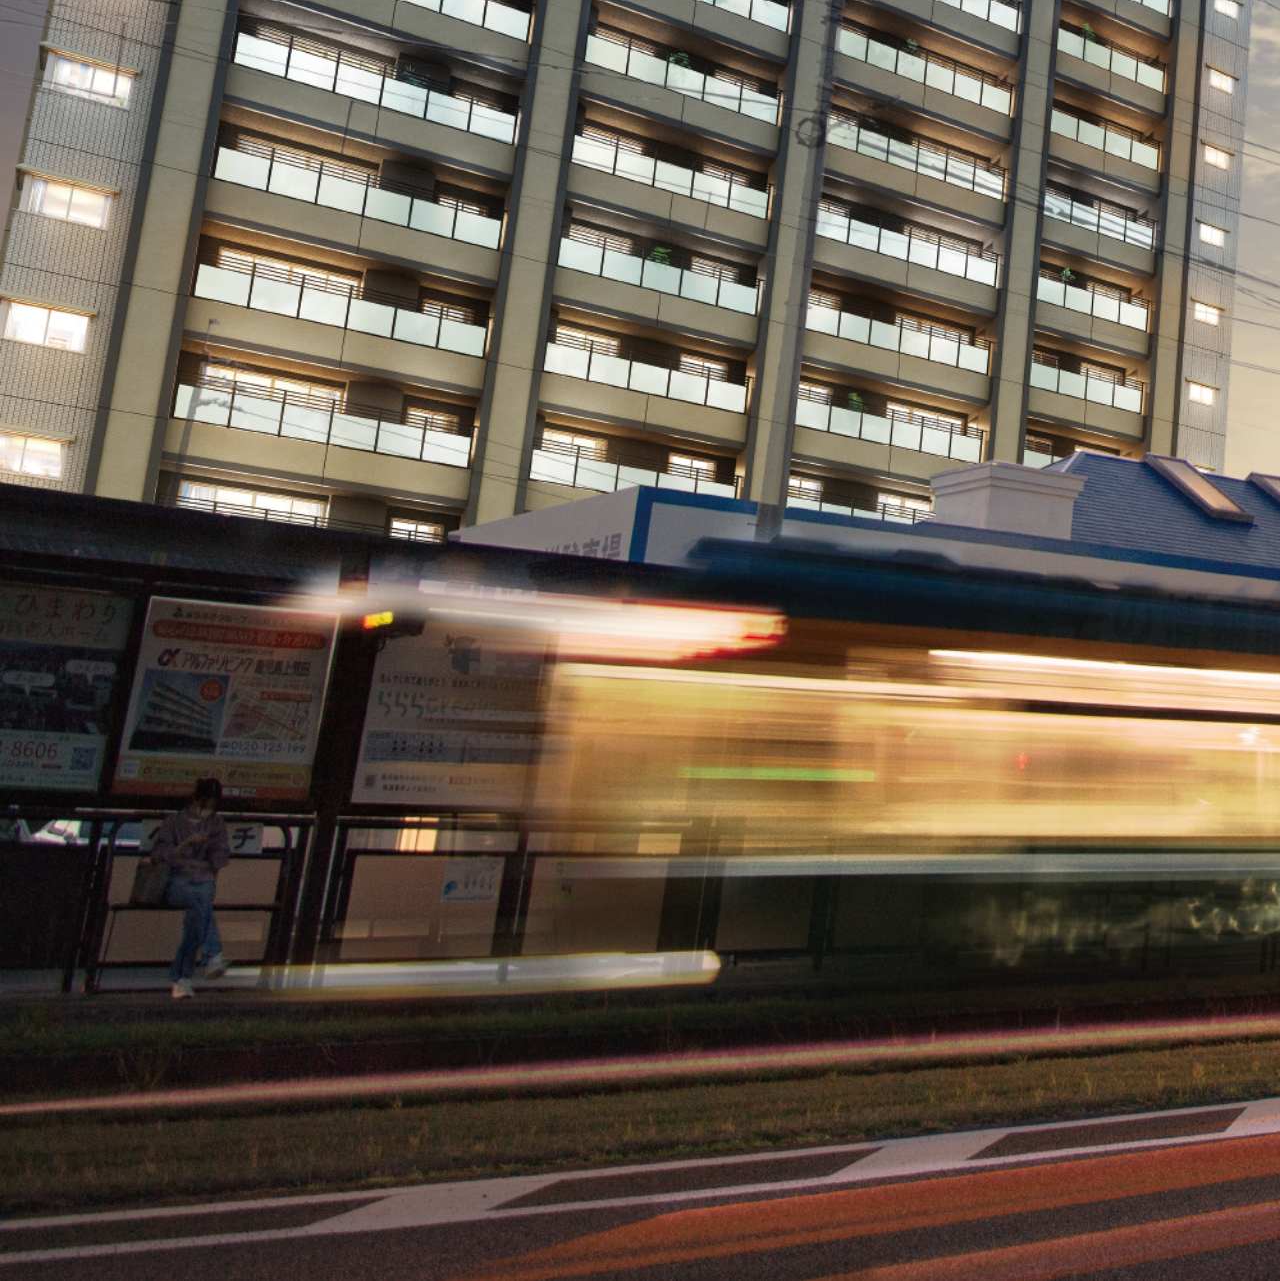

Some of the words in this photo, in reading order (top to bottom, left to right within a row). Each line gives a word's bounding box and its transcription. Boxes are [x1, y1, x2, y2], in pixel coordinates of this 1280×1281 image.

[15, 595, 116, 625] ひまわり
[0, 739, 58, 760] -8606
